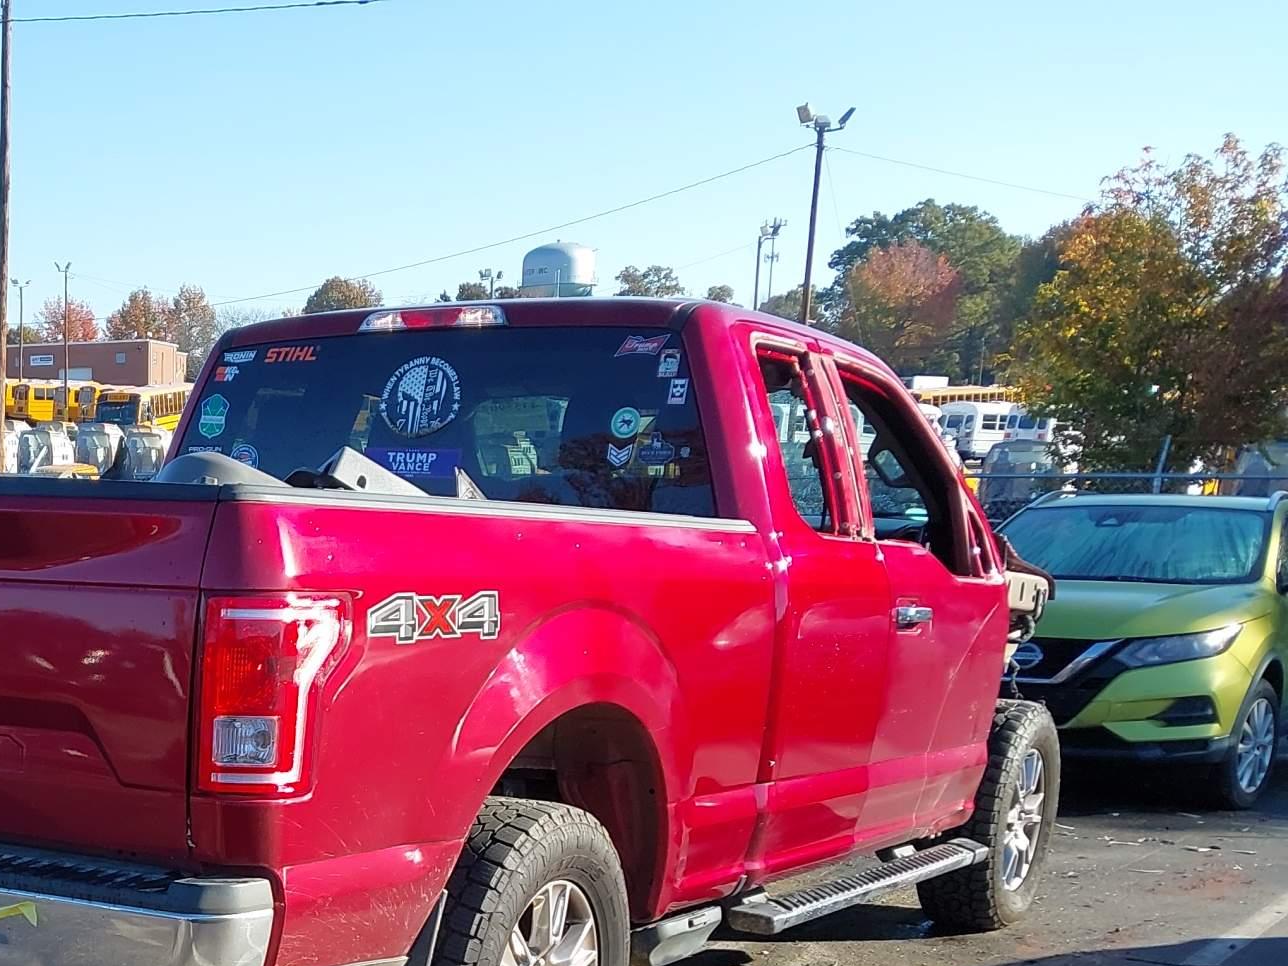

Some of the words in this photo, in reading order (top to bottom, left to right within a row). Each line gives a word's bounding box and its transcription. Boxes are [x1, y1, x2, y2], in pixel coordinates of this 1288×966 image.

[224, 351, 257, 363] RONIN
[264, 346, 317, 363] STIHL
[382, 376, 398, 400] WHEN
[394, 356, 431, 378] TYRANNY
[430, 356, 459, 382] BECOMES
[452, 380, 461, 400] LAW
[387, 452, 437, 463] TRUMP
[392, 462, 430, 472] VANCE
